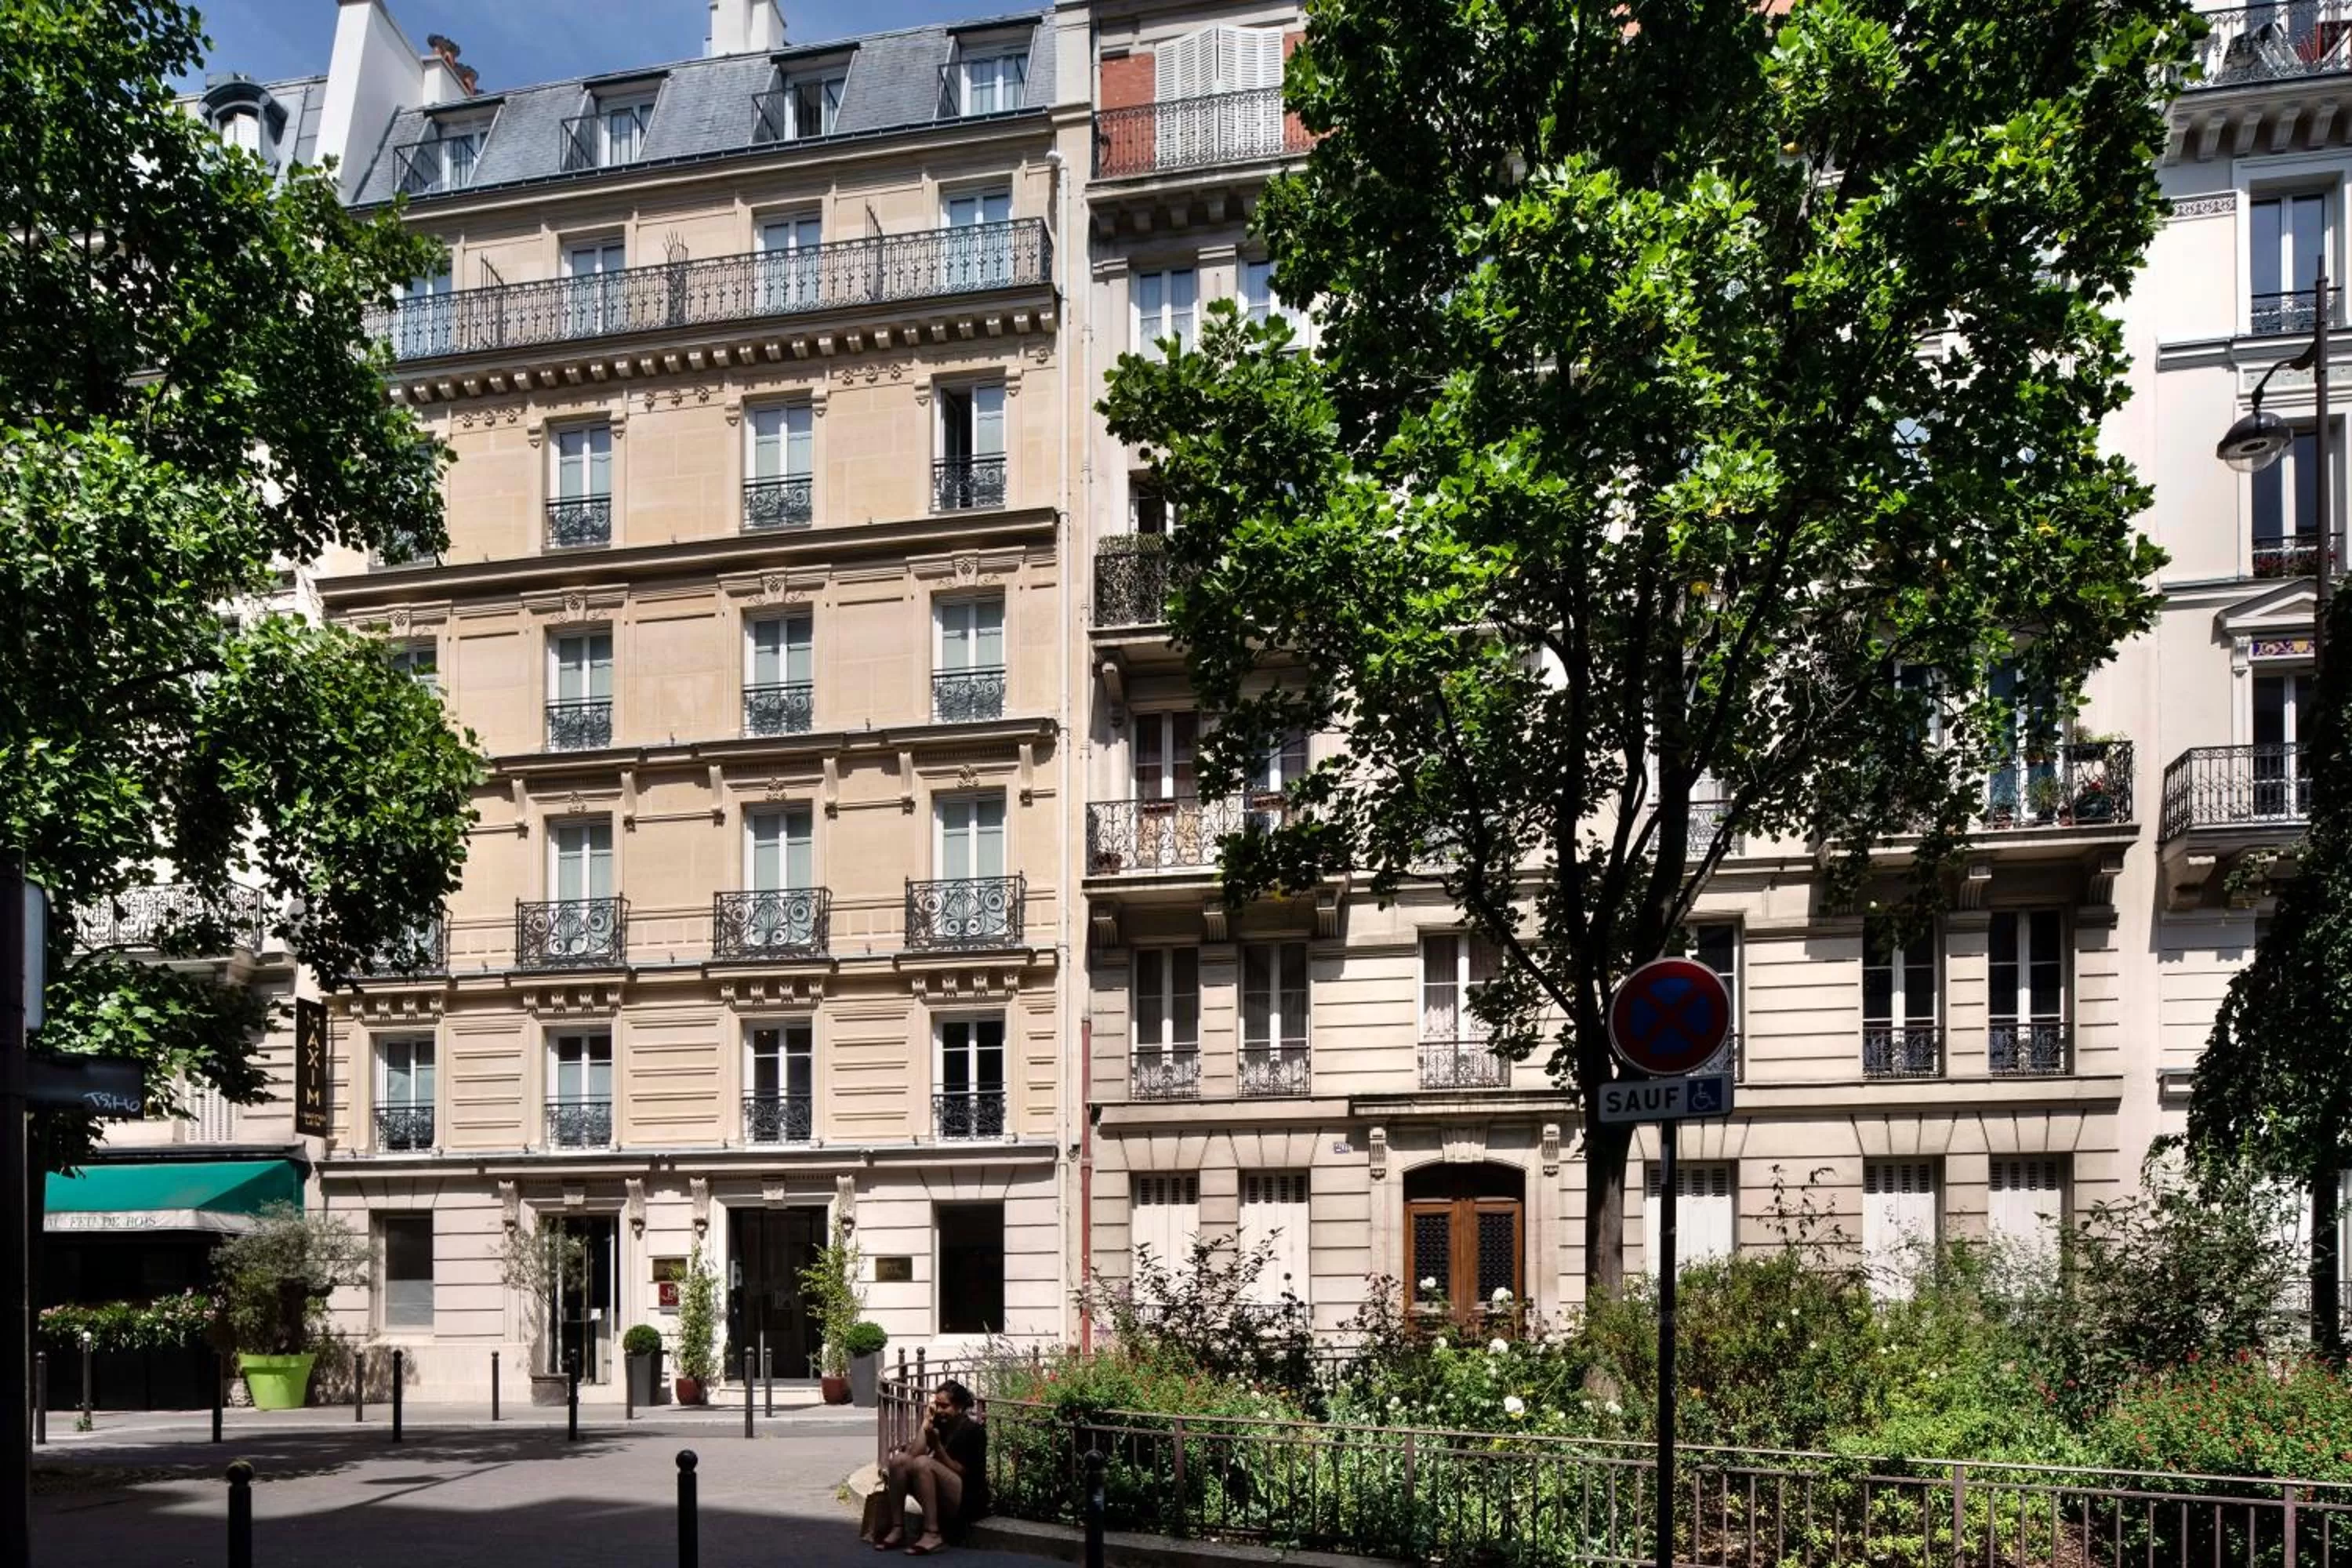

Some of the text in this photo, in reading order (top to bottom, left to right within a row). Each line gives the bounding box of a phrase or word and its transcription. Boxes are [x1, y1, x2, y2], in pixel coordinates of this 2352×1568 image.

[307, 1009, 320, 1107] MAXIM
[1606, 1087, 1679, 1113] SAUF
[103, 1216, 120, 1227] DE
